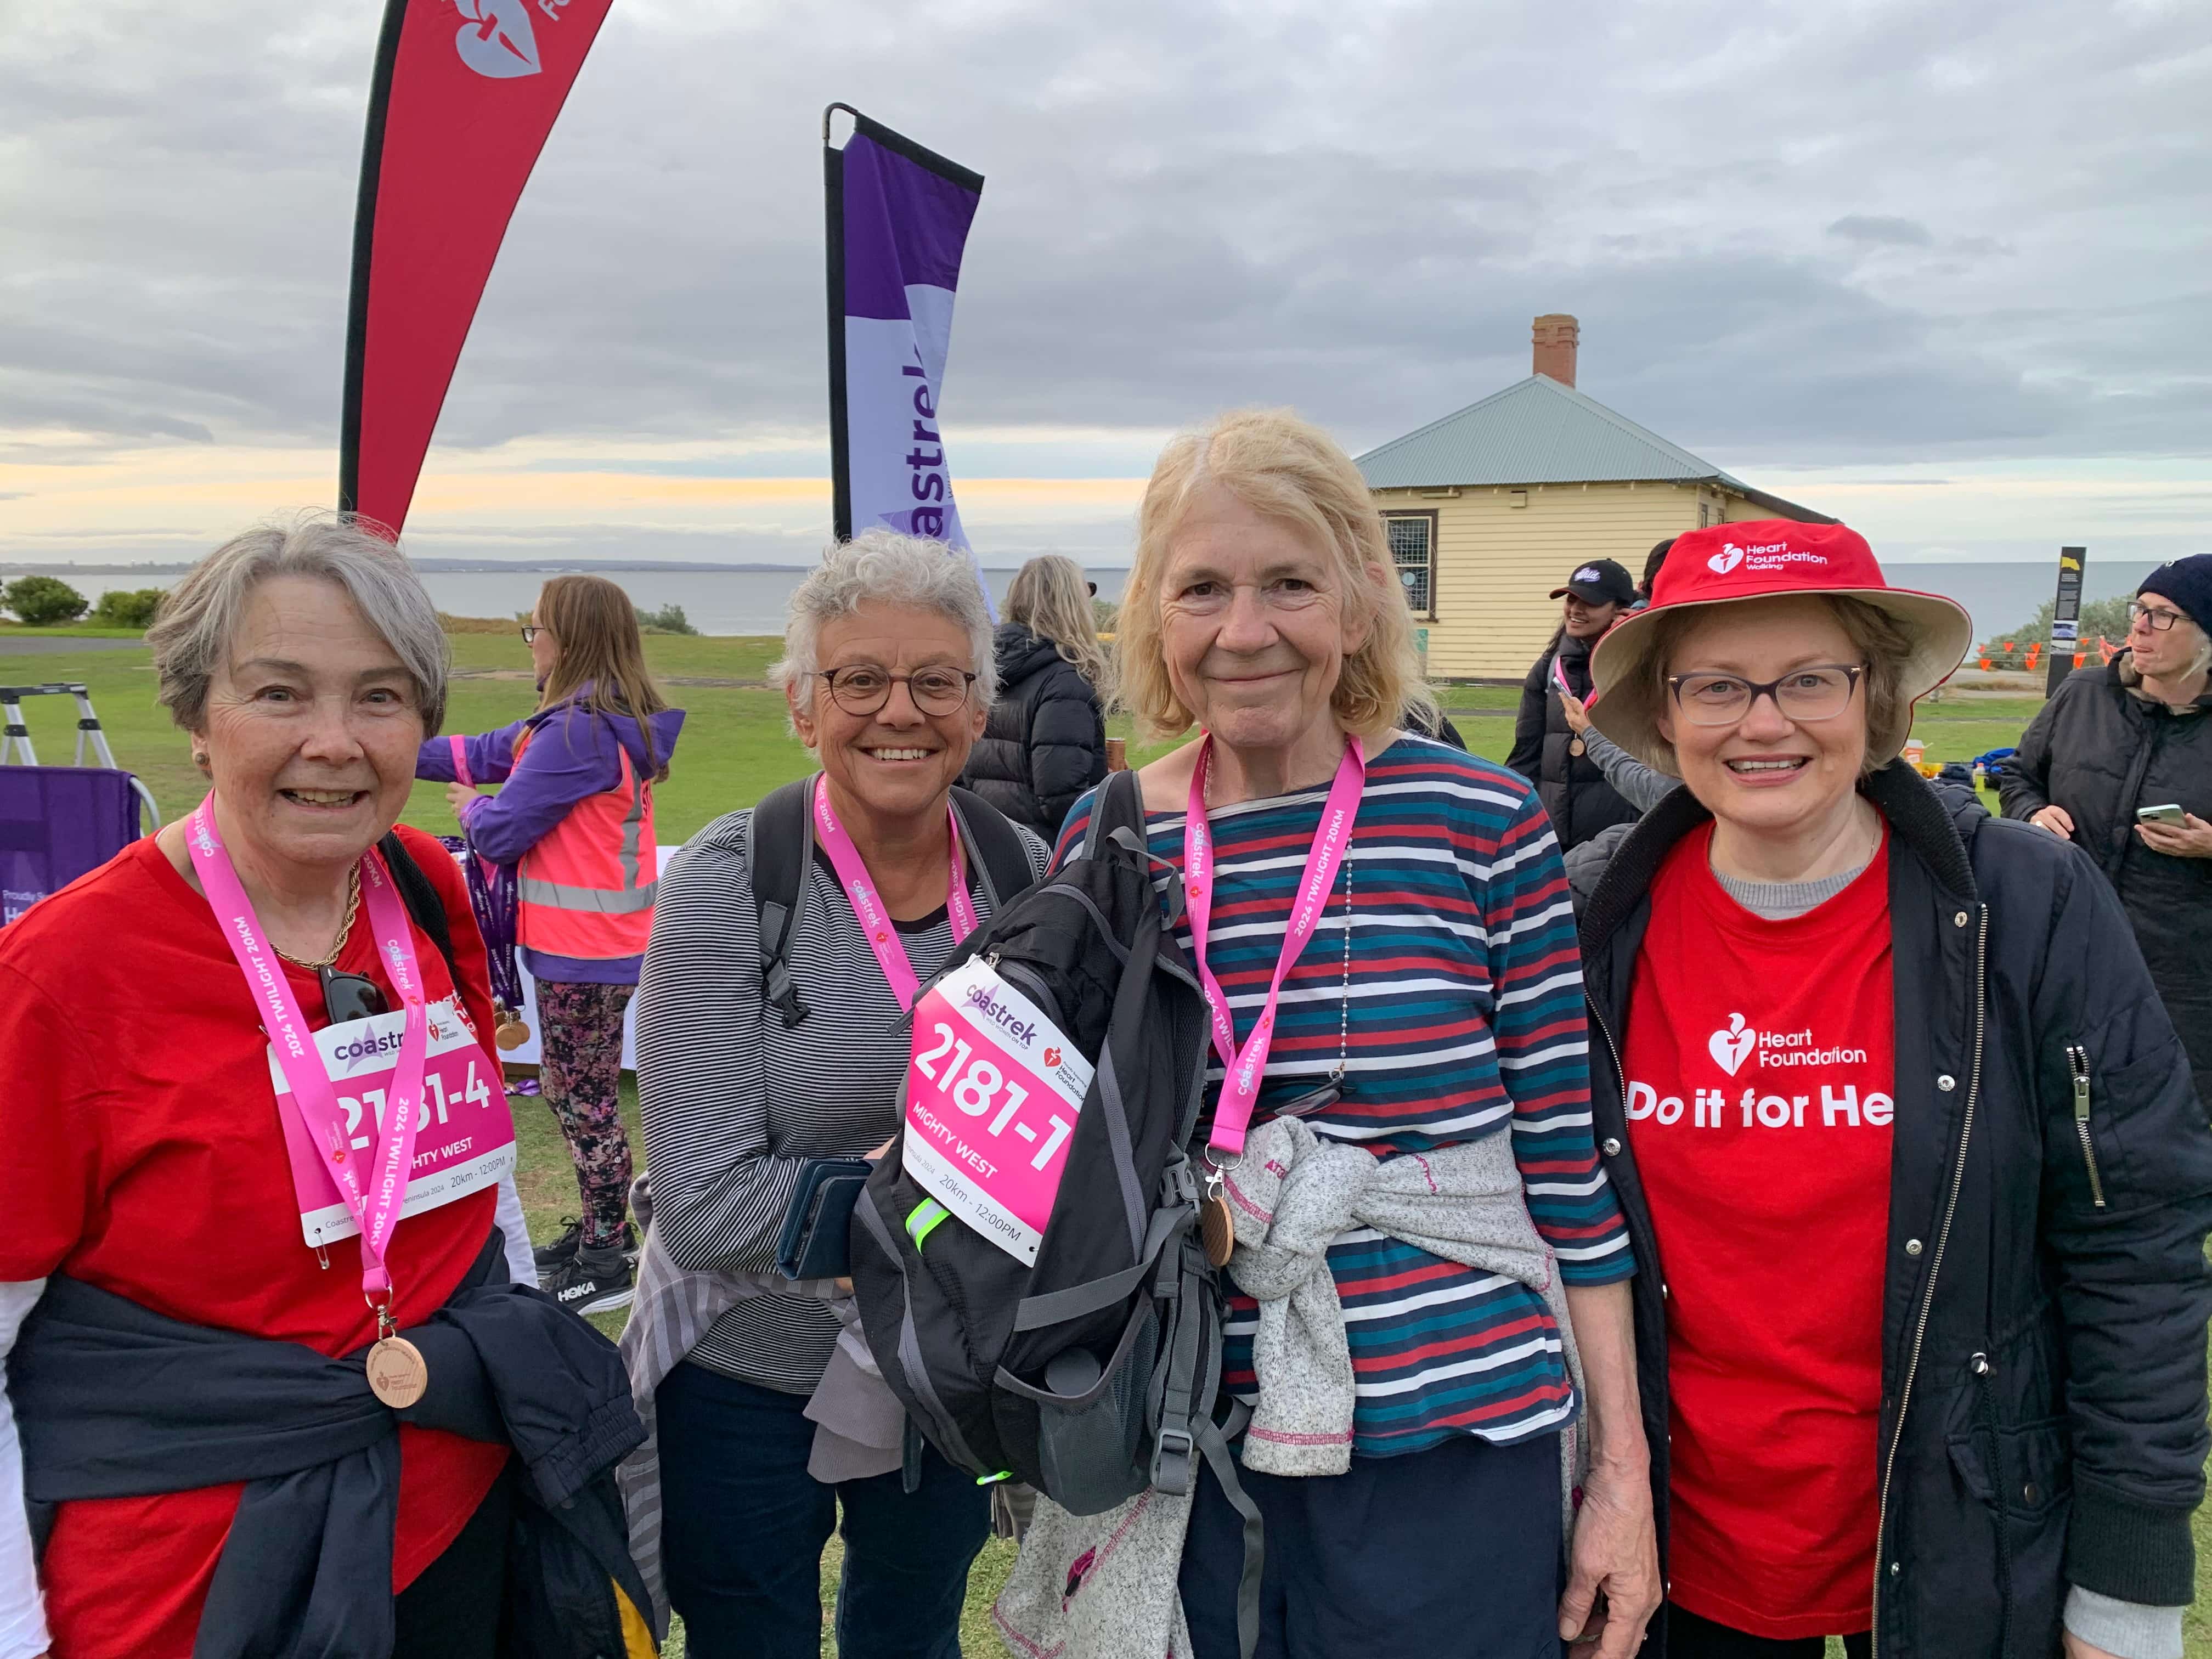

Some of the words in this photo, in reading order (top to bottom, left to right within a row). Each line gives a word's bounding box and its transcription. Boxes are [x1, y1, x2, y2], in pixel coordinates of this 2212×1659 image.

[1746, 541, 1788, 554] Heart
[1746, 551, 1829, 565] Foundation
[819, 803, 836, 833] 20KM
[1191, 823, 1205, 878] coastrek
[363, 854, 382, 888] 20KM
[1294, 906, 1313, 937] 2024
[1307, 843, 1333, 903] TWILIGHT
[1326, 809, 1345, 843] 20KM
[853, 879, 882, 927] coastrek
[232, 916, 259, 953] 20KM
[387, 939, 415, 991] coastrek
[251, 956, 288, 1023] TWILIGHT
[966, 984, 1038, 1046] coastrek
[280, 1023, 305, 1058] 2024
[995, 1024, 1012, 1039] WOMEN
[1011, 1036, 1019, 1045] ON
[1019, 1042, 1029, 1051] TOP
[1758, 1028, 1813, 1048] Heart
[1059, 1064, 1076, 1084] Heart
[1238, 1036, 1265, 1096] coastrek
[1759, 1046, 1867, 1068] Foundation
[394, 1097, 410, 1132] 2024
[914, 1022, 1073, 1172] 2181-1
[1627, 1080, 1684, 1126] Do
[1695, 1088, 1725, 1128] it
[1740, 1088, 1809, 1128] for
[1820, 1084, 1894, 1127] He
[441, 1136, 472, 1159] WEST
[912, 1101, 957, 1146] MIGHTY
[955, 1139, 999, 1180] WEST
[379, 1136, 404, 1209] TWILIGHT
[451, 1172, 473, 1188] 20km
[479, 1155, 506, 1177] 12:00PM
[921, 1160, 935, 1175] 2024
[431, 1184, 444, 1195] 2024
[939, 1174, 968, 1203] 20km
[975, 1203, 1022, 1242] 12:00PM
[557, 1281, 596, 1302] HOKA
